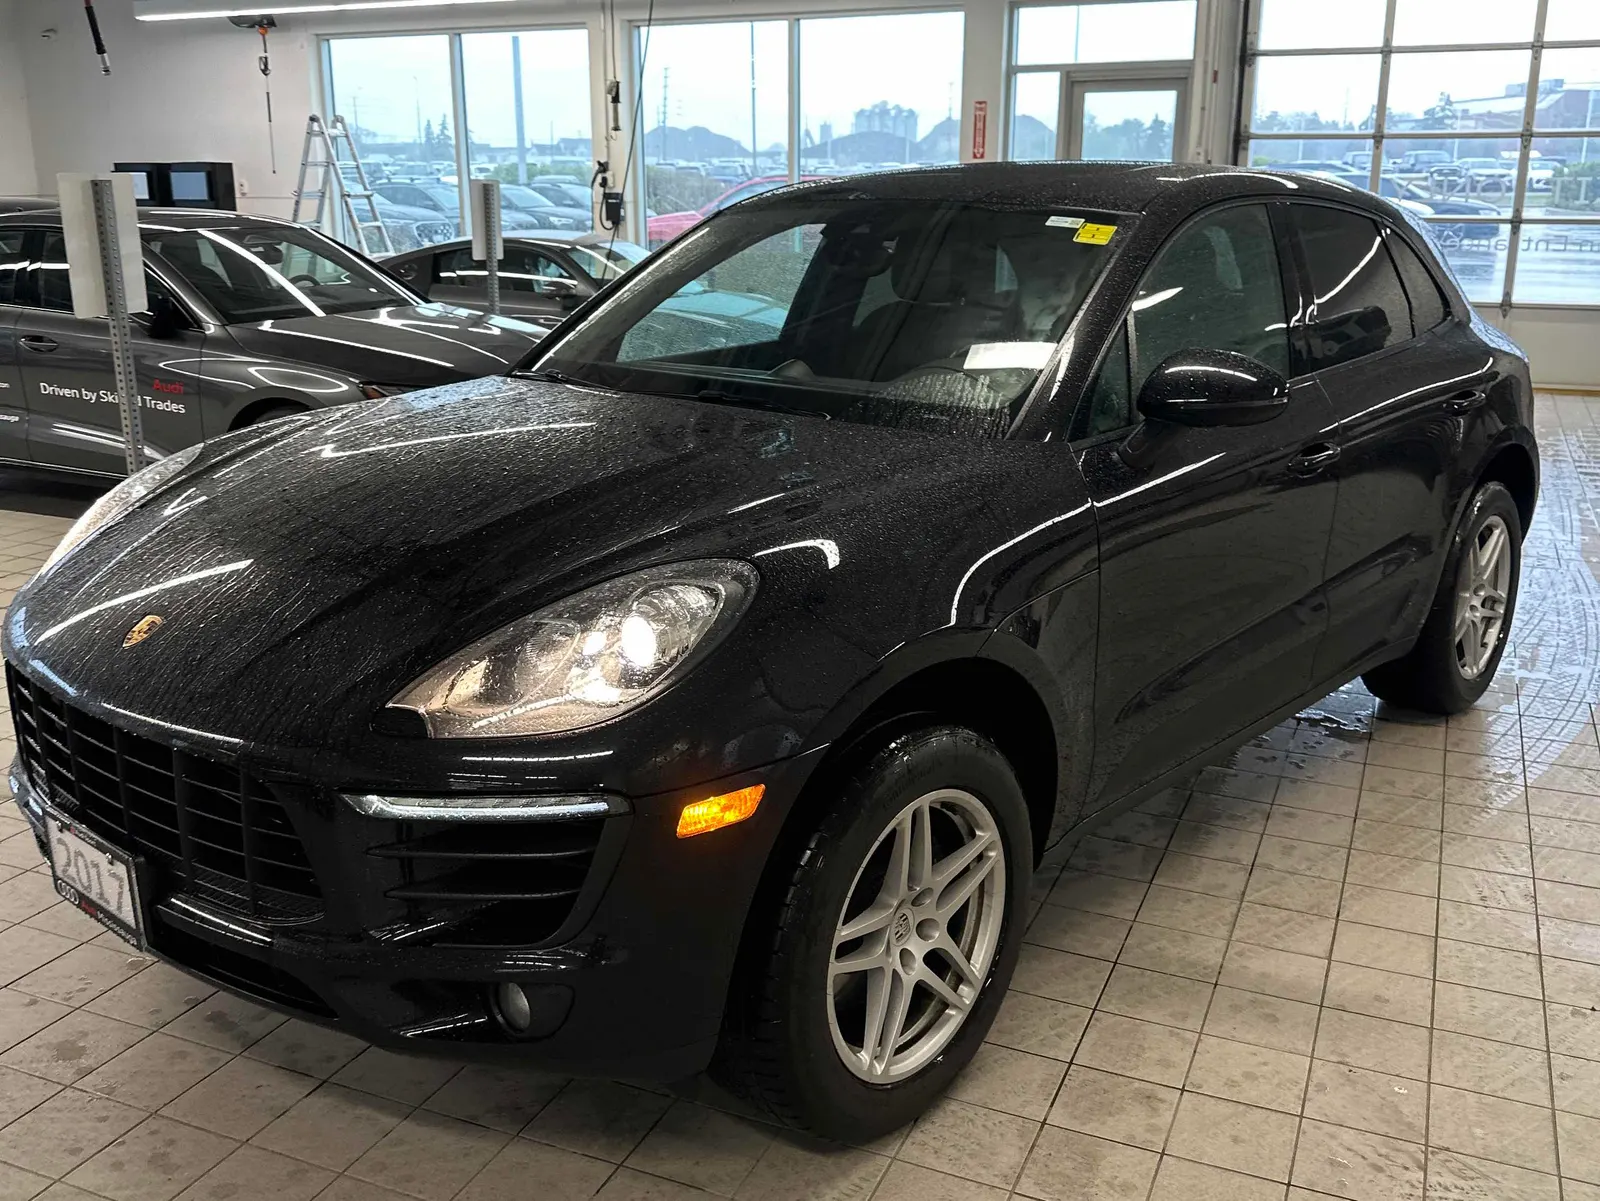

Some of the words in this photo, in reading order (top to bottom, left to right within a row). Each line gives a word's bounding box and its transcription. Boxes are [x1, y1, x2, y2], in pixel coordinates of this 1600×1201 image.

[39, 382, 80, 398] Driven
[81, 388, 97, 403] by
[143, 396, 186, 413] Trades
[152, 378, 184, 394] Audi
[55, 837, 124, 915] 2017
